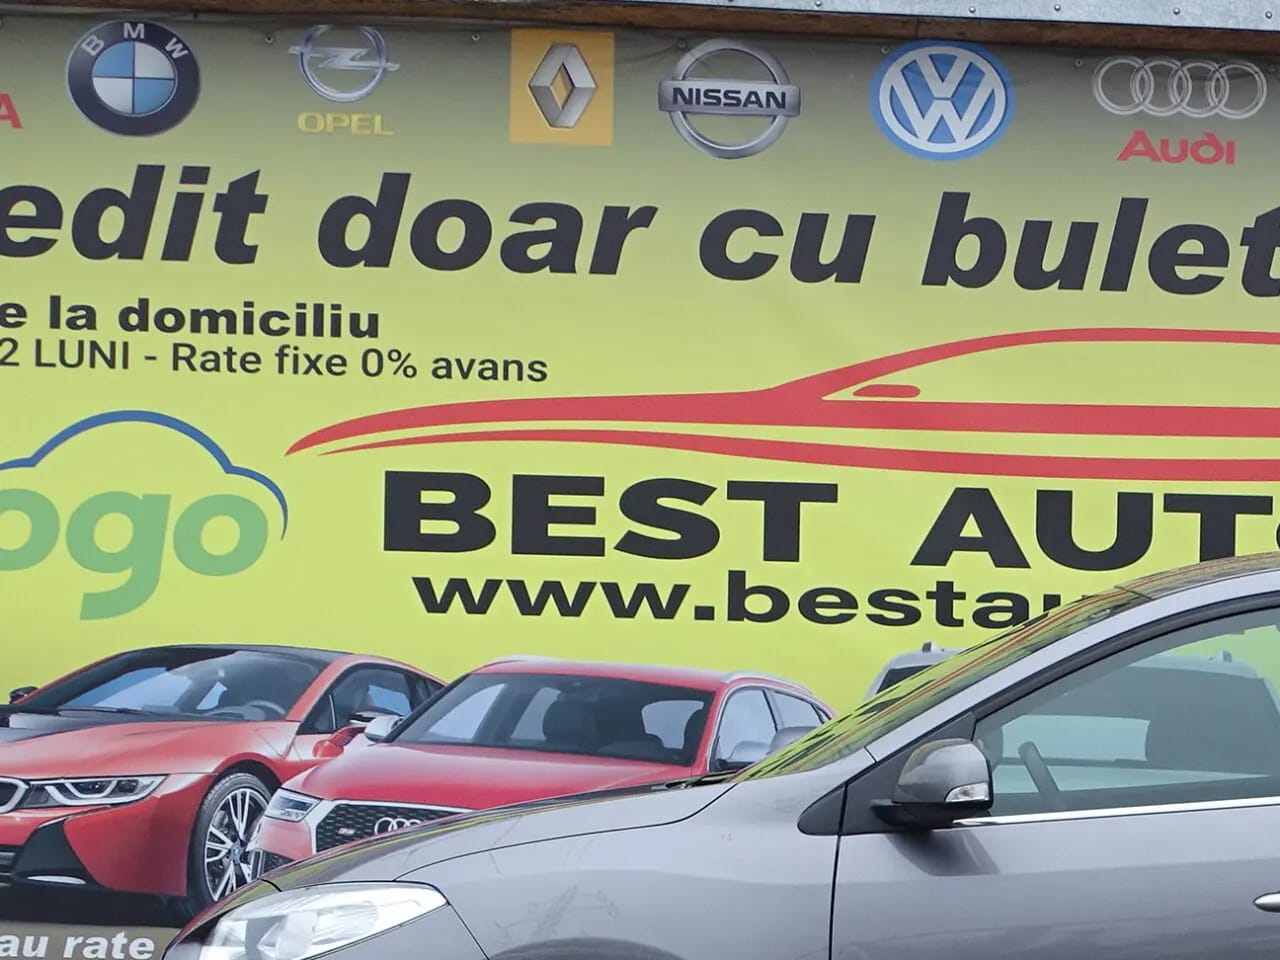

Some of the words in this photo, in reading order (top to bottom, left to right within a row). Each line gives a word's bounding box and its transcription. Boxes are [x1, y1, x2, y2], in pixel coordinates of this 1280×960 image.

[80, 22, 190, 60] BMW
[672, 86, 787, 110] NISSAN
[297, 111, 395, 136] OPEL
[1116, 128, 1236, 165] Audi
[317, 171, 659, 276] doar
[698, 208, 878, 284] cu
[49, 294, 98, 331] la
[117, 296, 380, 340] domiciliu
[34, 338, 130, 370] LUNI
[171, 341, 263, 374] Rate
[275, 343, 348, 376] fixe
[360, 347, 418, 379] 0%
[430, 355, 549, 383] avans
[383, 470, 839, 562] BEST
[411, 569, 1062, 631] www.besta
[63, 931, 155, 960] rate
